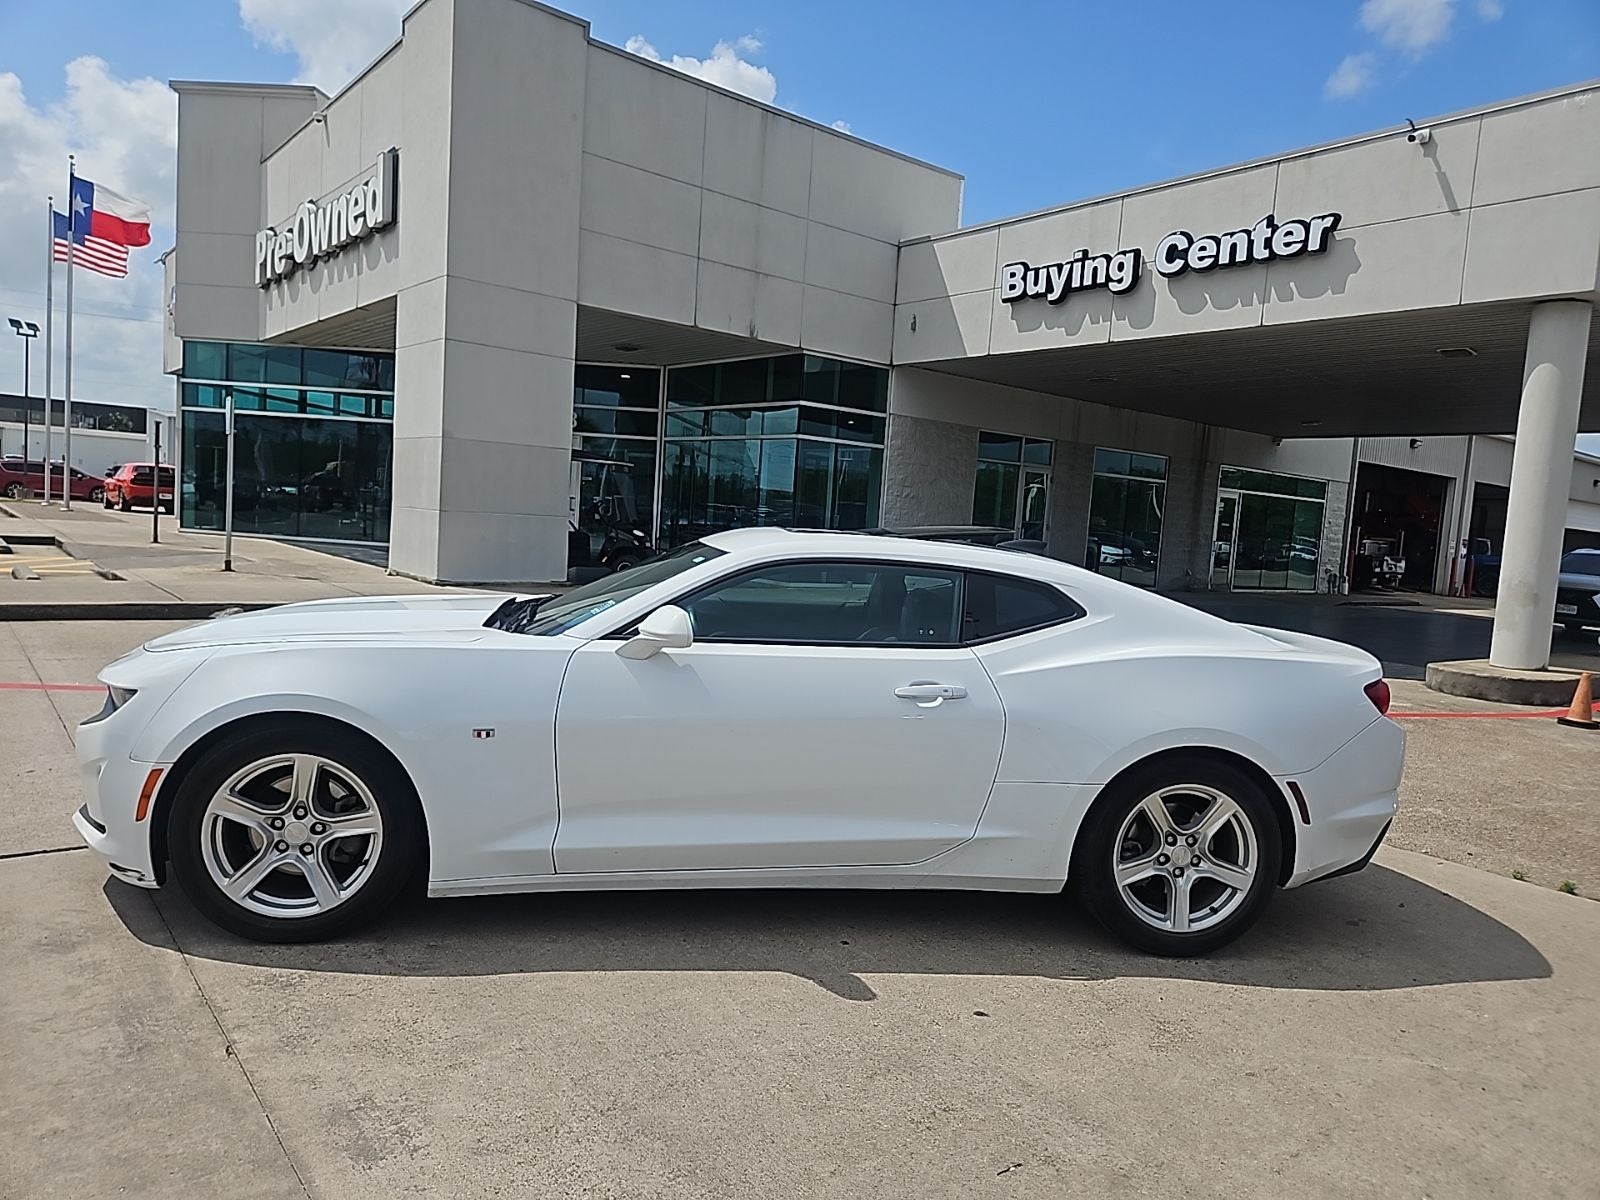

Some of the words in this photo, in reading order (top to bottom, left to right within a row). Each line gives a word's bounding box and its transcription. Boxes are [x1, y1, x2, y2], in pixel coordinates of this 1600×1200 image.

[255, 150, 395, 288] Pre-Owned
[1001, 249, 1140, 303] Buying
[1155, 214, 1340, 276] Center
